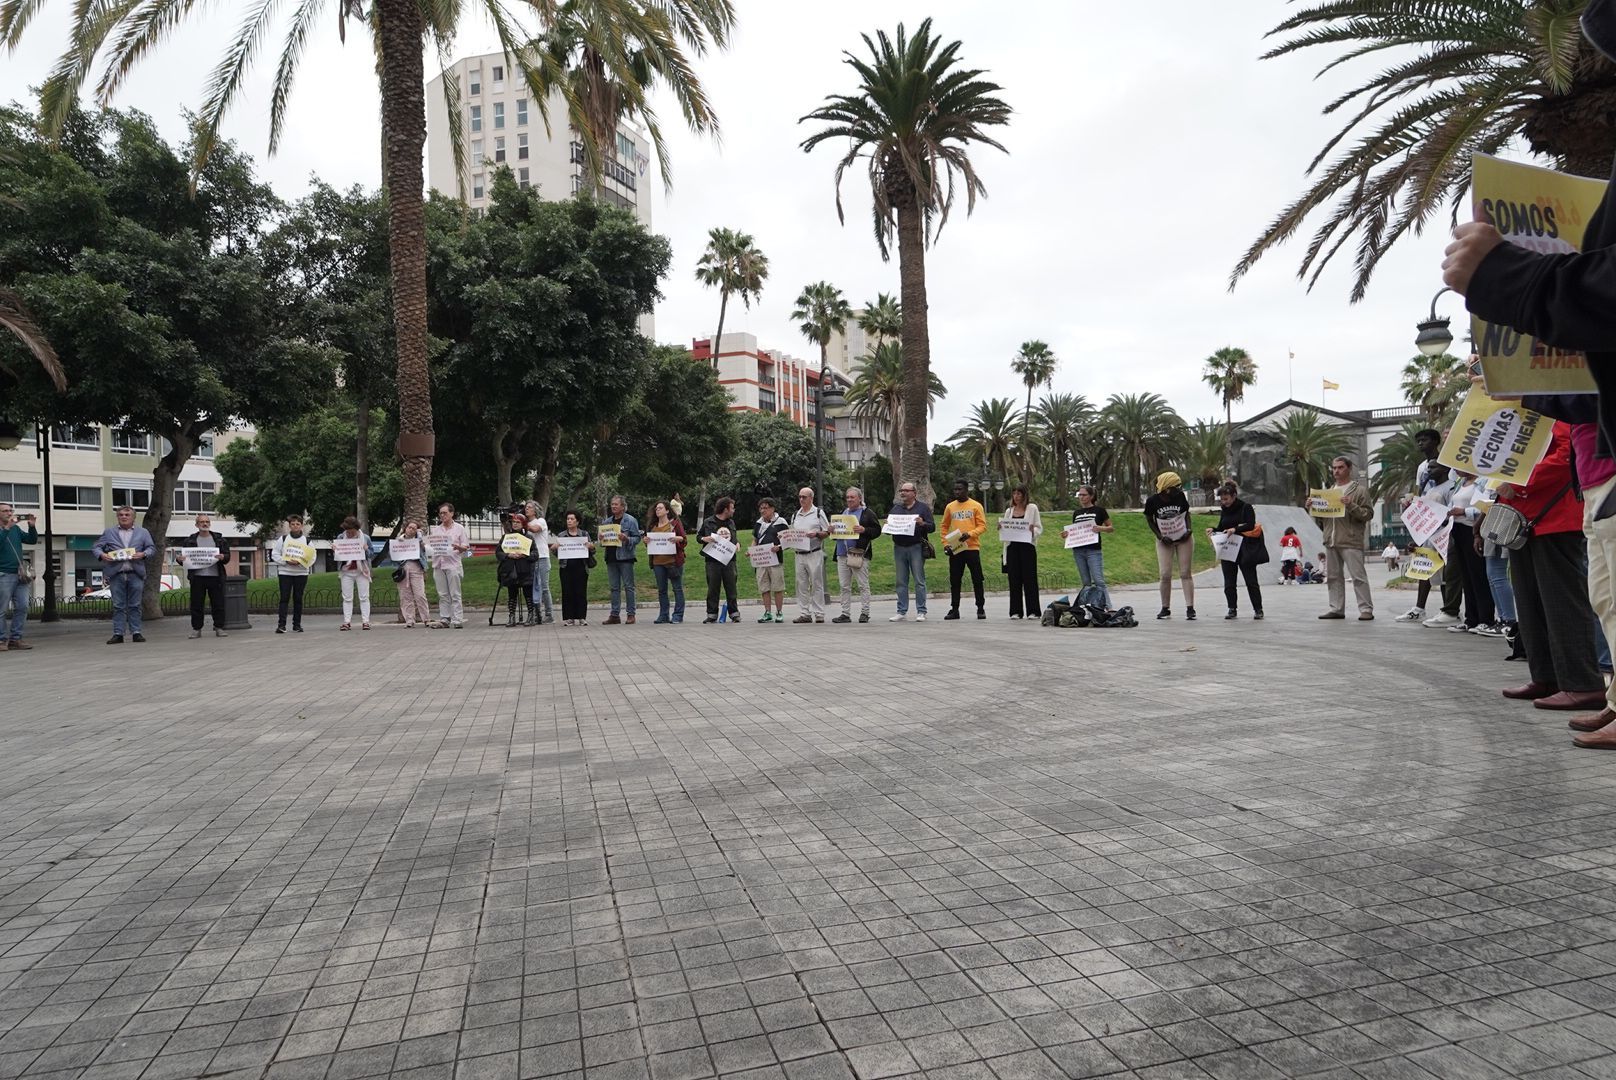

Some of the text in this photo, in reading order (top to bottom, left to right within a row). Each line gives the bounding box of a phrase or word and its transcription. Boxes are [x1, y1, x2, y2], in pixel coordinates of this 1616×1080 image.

[1482, 198, 1558, 238] SOMOS
[1455, 419, 1485, 464] SOMOS
[1477, 409, 1518, 469] VECINAS,
[1500, 457, 1519, 477] NO
[1413, 560, 1433, 568] VECINAS
